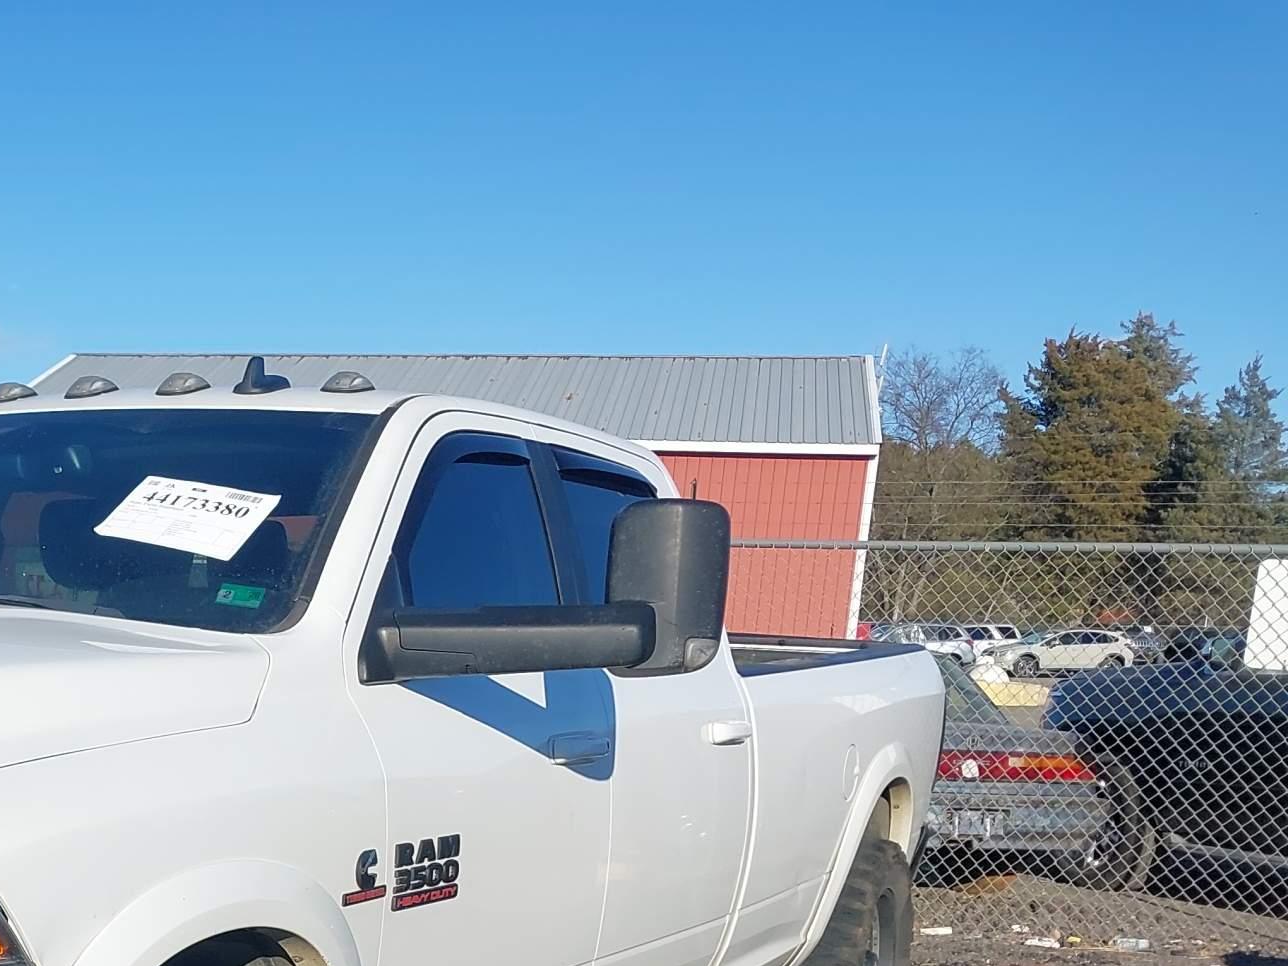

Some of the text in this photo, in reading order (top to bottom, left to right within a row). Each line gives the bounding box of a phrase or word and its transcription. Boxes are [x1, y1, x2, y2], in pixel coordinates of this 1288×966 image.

[143, 491, 250, 519] 44173380
[394, 834, 461, 868] RAM
[393, 859, 460, 894] 3500
[397, 891, 431, 908] HEAVY
[430, 886, 457, 902] DUTY
